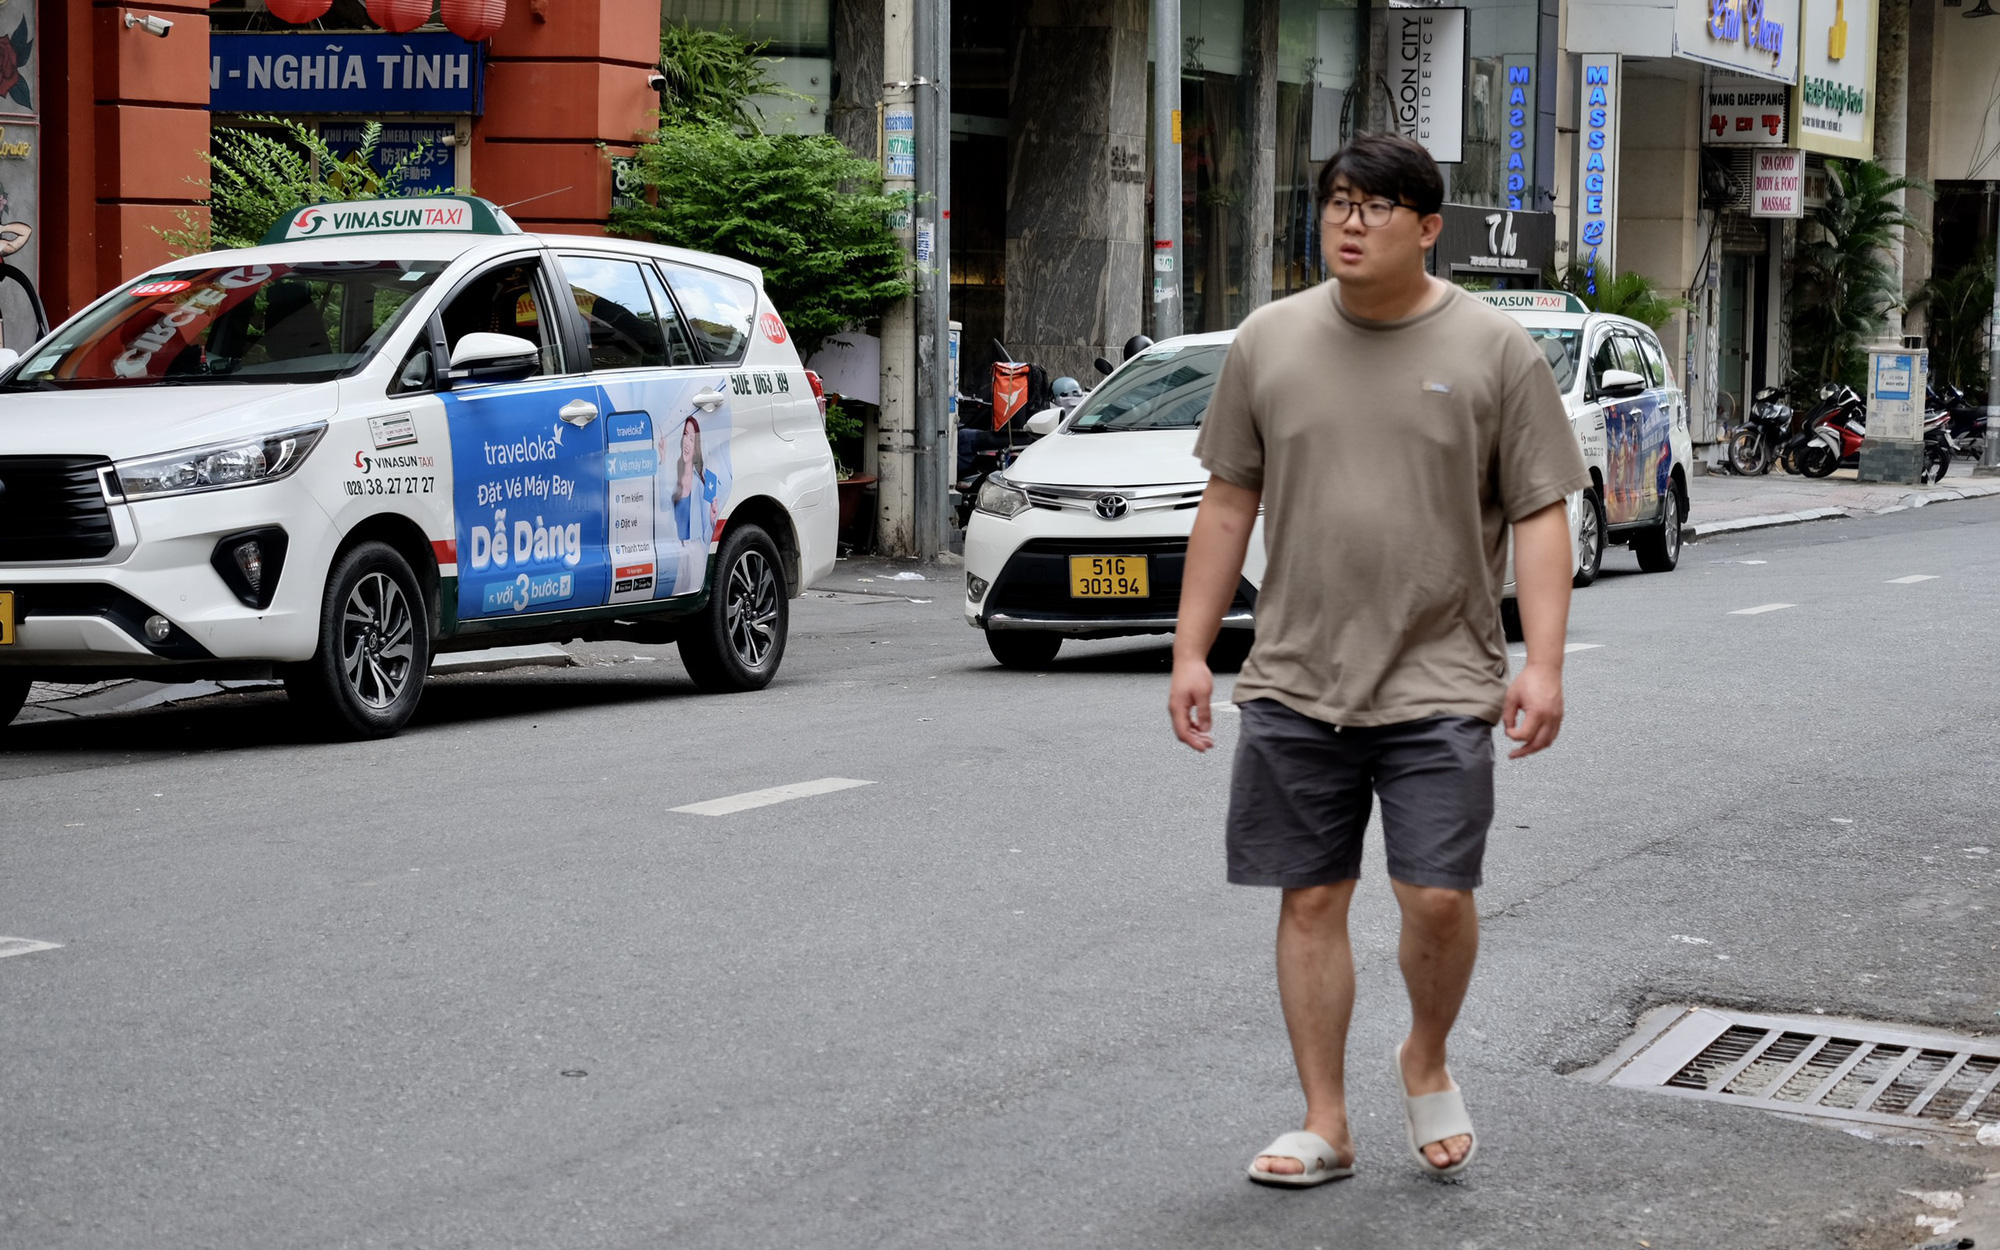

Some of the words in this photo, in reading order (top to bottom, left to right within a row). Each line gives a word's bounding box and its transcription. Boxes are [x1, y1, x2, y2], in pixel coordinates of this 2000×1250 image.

[1402, 17, 1418, 60] CITY
[248, 44, 366, 89] NGHĨA
[377, 45, 468, 89] TÌNH
[1421, 17, 1432, 139] ESIDENCE
[1400, 69, 1417, 140] AIGON
[1710, 94, 1734, 106] WANG
[1738, 94, 1784, 106] DAEPPANG
[324, 130, 340, 142] KHU
[380, 130, 409, 142] AMERA
[412, 130, 434, 143] QUAN
[1586, 66, 1608, 214] MASSAGE
[1761, 156, 1772, 170] SPA
[1774, 156, 1794, 170] GOOD
[1756, 177, 1774, 190] BODY
[1775, 177, 1780, 190] &
[1781, 177, 1798, 190] FOOT
[1761, 196, 1792, 211] MASSAGE
[1536, 297, 1561, 307] TAXI
[617, 424, 642, 436] traveloka
[484, 435, 556, 465] traveloka
[374, 456, 418, 468] VINASUN
[418, 457, 434, 467] TAXI
[405, 477, 418, 494] 27
[422, 477, 434, 493] 27
[477, 482, 502, 508] Đặt
[505, 477, 522, 499] Vé
[524, 475, 550, 500] Máy
[552, 475, 575, 500] Bay
[471, 508, 508, 570] Dễ
[514, 515, 581, 568] Dàng
[1093, 559, 1125, 575] 51G
[496, 586, 514, 605] với
[514, 573, 530, 612] 3
[531, 578, 558, 599] bước
[1080, 578, 1139, 594] 303.94
